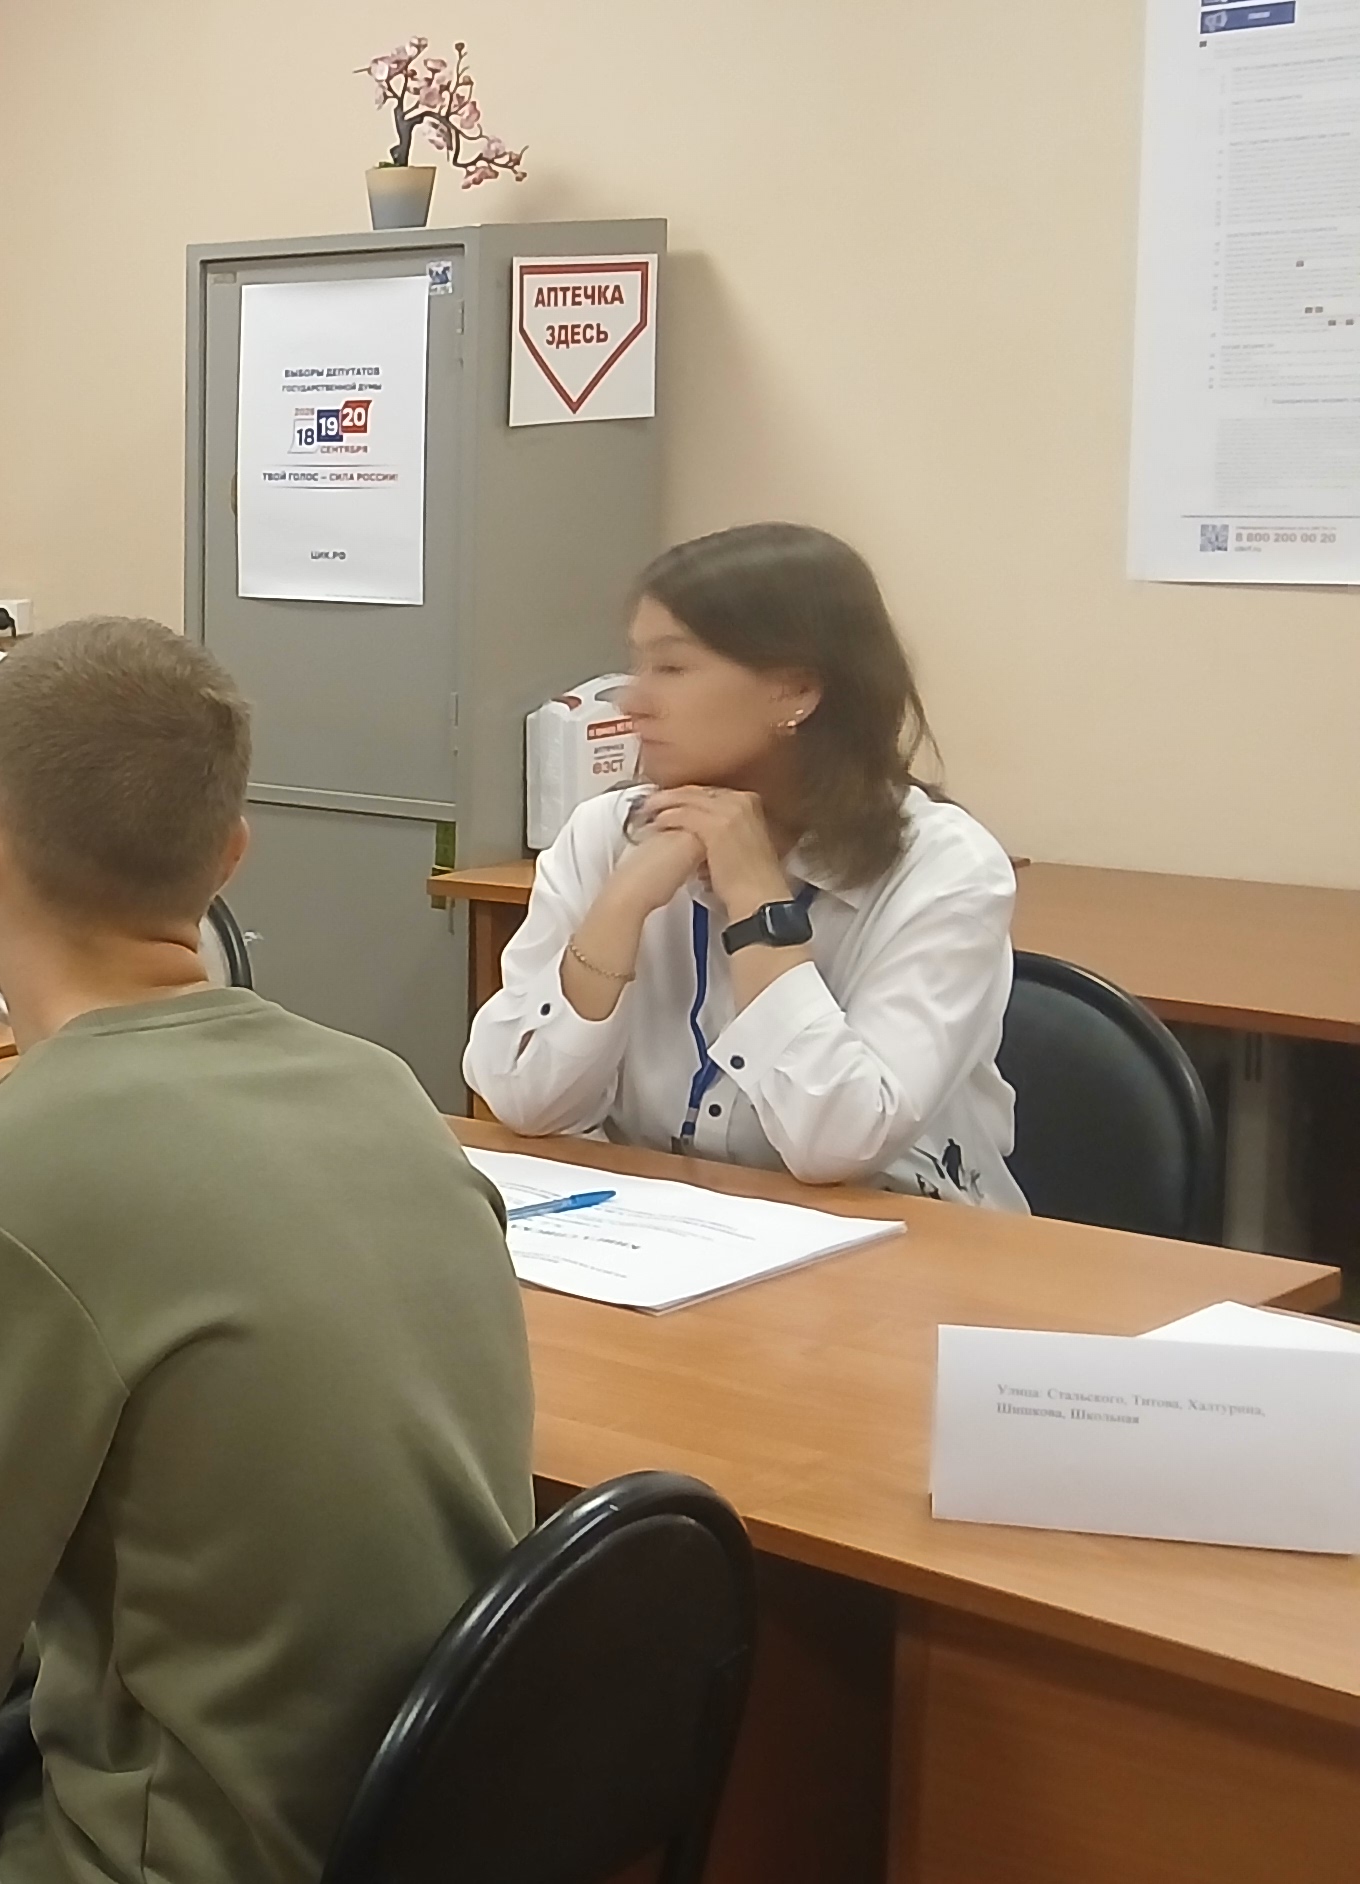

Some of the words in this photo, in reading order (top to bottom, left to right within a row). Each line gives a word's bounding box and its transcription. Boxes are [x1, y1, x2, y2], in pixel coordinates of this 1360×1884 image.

[534, 284, 624, 308] АПТЕЧКА
[545, 322, 609, 349] ЗДЕСЬ
[284, 369, 324, 378] ВЫБОРЫ
[326, 367, 380, 378] ДЕПУТАТОВ
[282, 382, 356, 392] ГОСУДАРСТВЕННОЙ
[358, 383, 382, 392] ДУМЫ
[296, 428, 315, 446] 18
[318, 417, 338, 436] 19
[342, 407, 366, 426] 20
[320, 446, 368, 454] СЕНТЯБРЯ
[263, 471, 286, 481] ТВОЙ
[288, 472, 318, 481] ГОЛОС
[329, 472, 354, 481] СИЛА
[357, 472, 398, 481] РОССИИ!
[1246, 532, 1270, 543] 800
[1273, 532, 1297, 543] 200
[1300, 533, 1317, 543] 00
[1319, 533, 1336, 543] 20
[311, 550, 346, 562] ЦИК.РФ
[1047, 1387, 1128, 1406] Стальского,
[1131, 1393, 1183, 1411] Титова,
[1187, 1399, 1266, 1418] Халтурина,
[996, 1402, 1065, 1420] Шишкова,
[1070, 1408, 1140, 1425] Школьная
